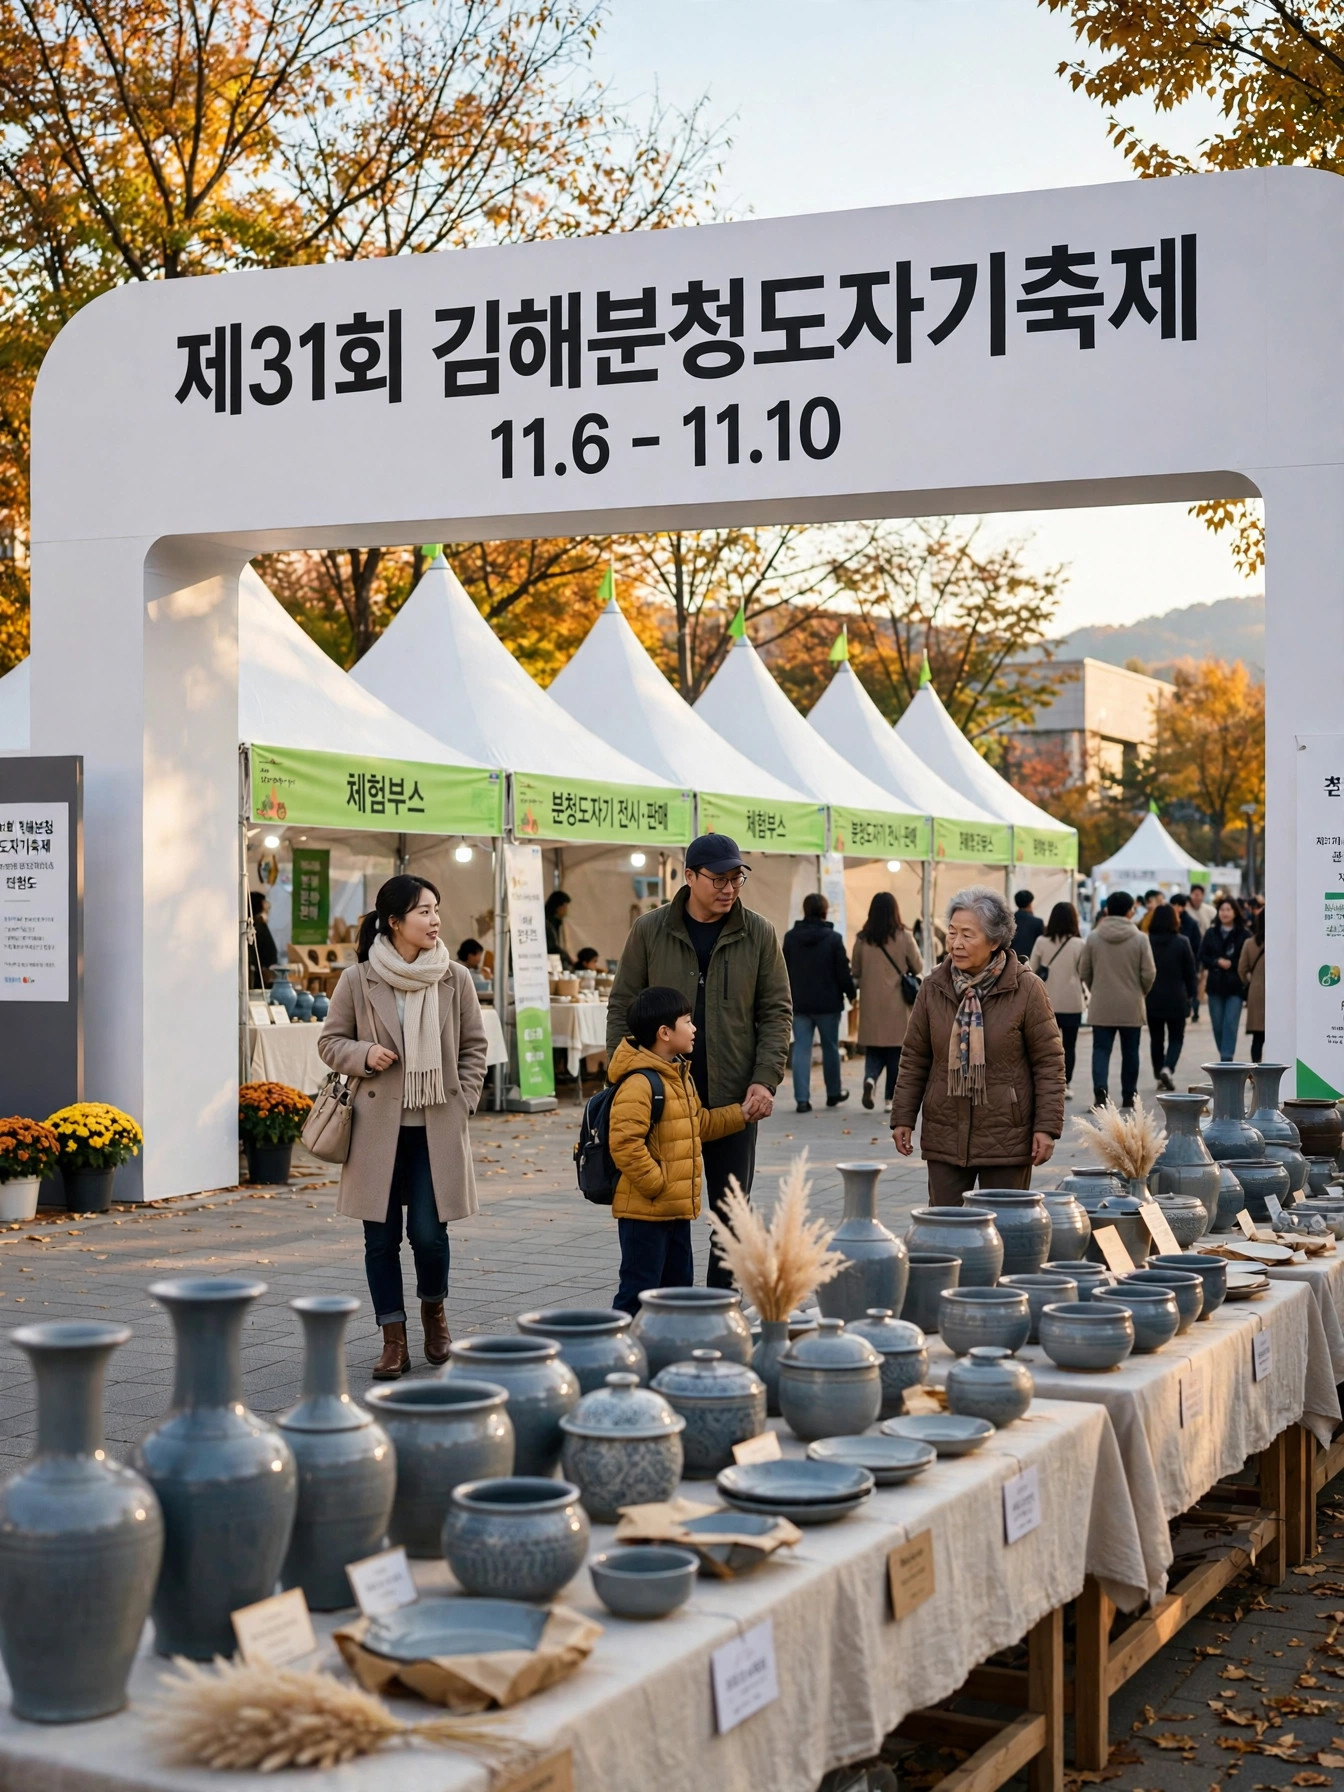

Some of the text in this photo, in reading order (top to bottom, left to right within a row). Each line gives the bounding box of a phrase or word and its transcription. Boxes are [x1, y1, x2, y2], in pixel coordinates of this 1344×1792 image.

[175, 233, 1198, 415] 제31회 김해분청도자기축제
[491, 413, 610, 479] 11.6
[683, 396, 841, 467] 11.10
[346, 772, 425, 816] 체험부스
[551, 791, 613, 829] 분청도자기
[746, 809, 786, 839] 체험부스
